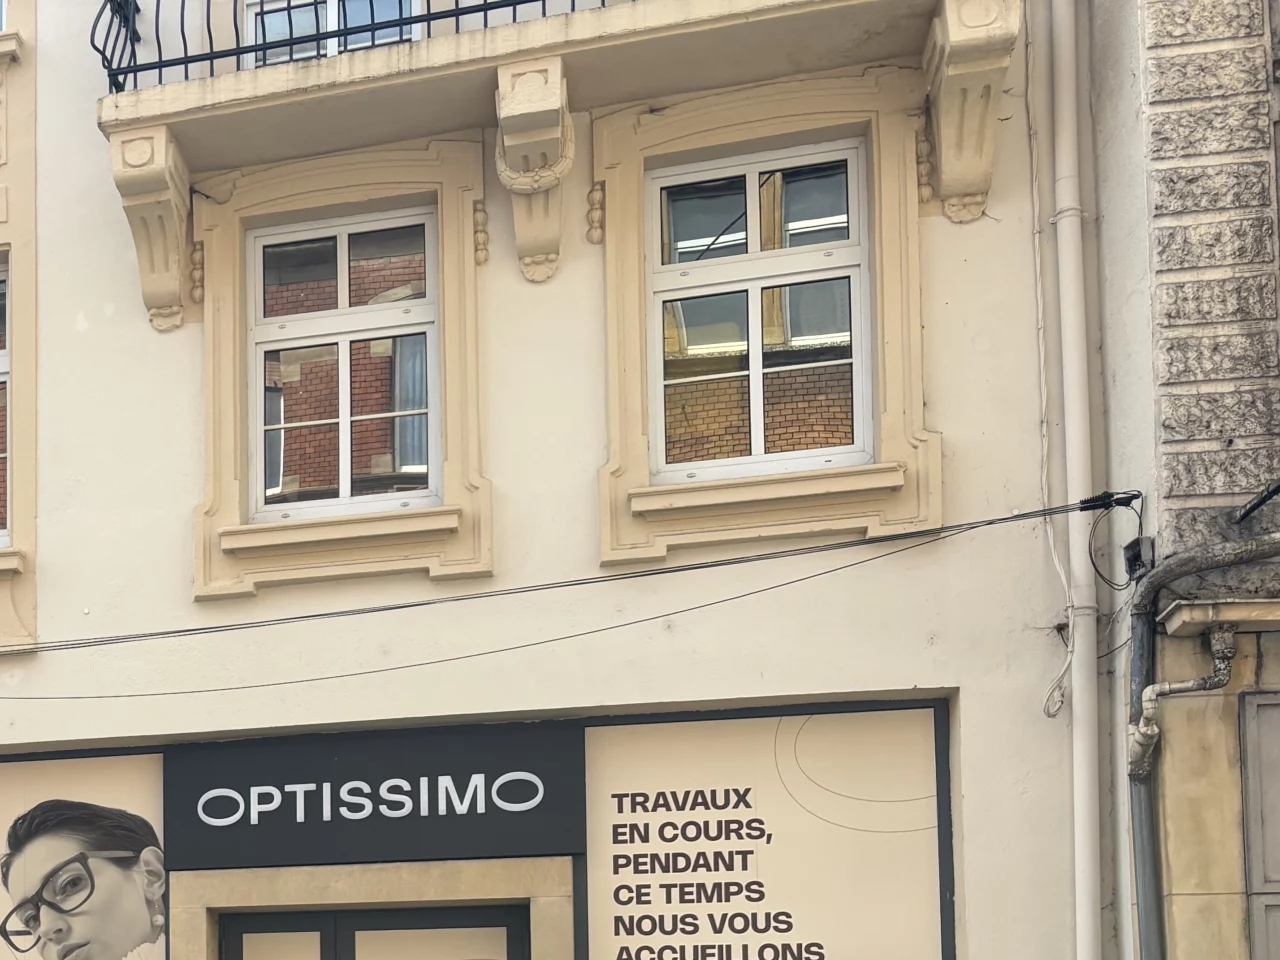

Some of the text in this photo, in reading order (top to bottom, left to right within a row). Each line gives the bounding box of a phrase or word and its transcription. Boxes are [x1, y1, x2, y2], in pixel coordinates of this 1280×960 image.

[197, 771, 544, 826] OPTISSIMO
[611, 788, 752, 813] TRAVAUX
[612, 819, 772, 845] EN COURS,
[613, 850, 754, 875] PENDANT
[613, 881, 765, 905] CE TEMPS
[614, 912, 793, 936] NOUS VOUS
